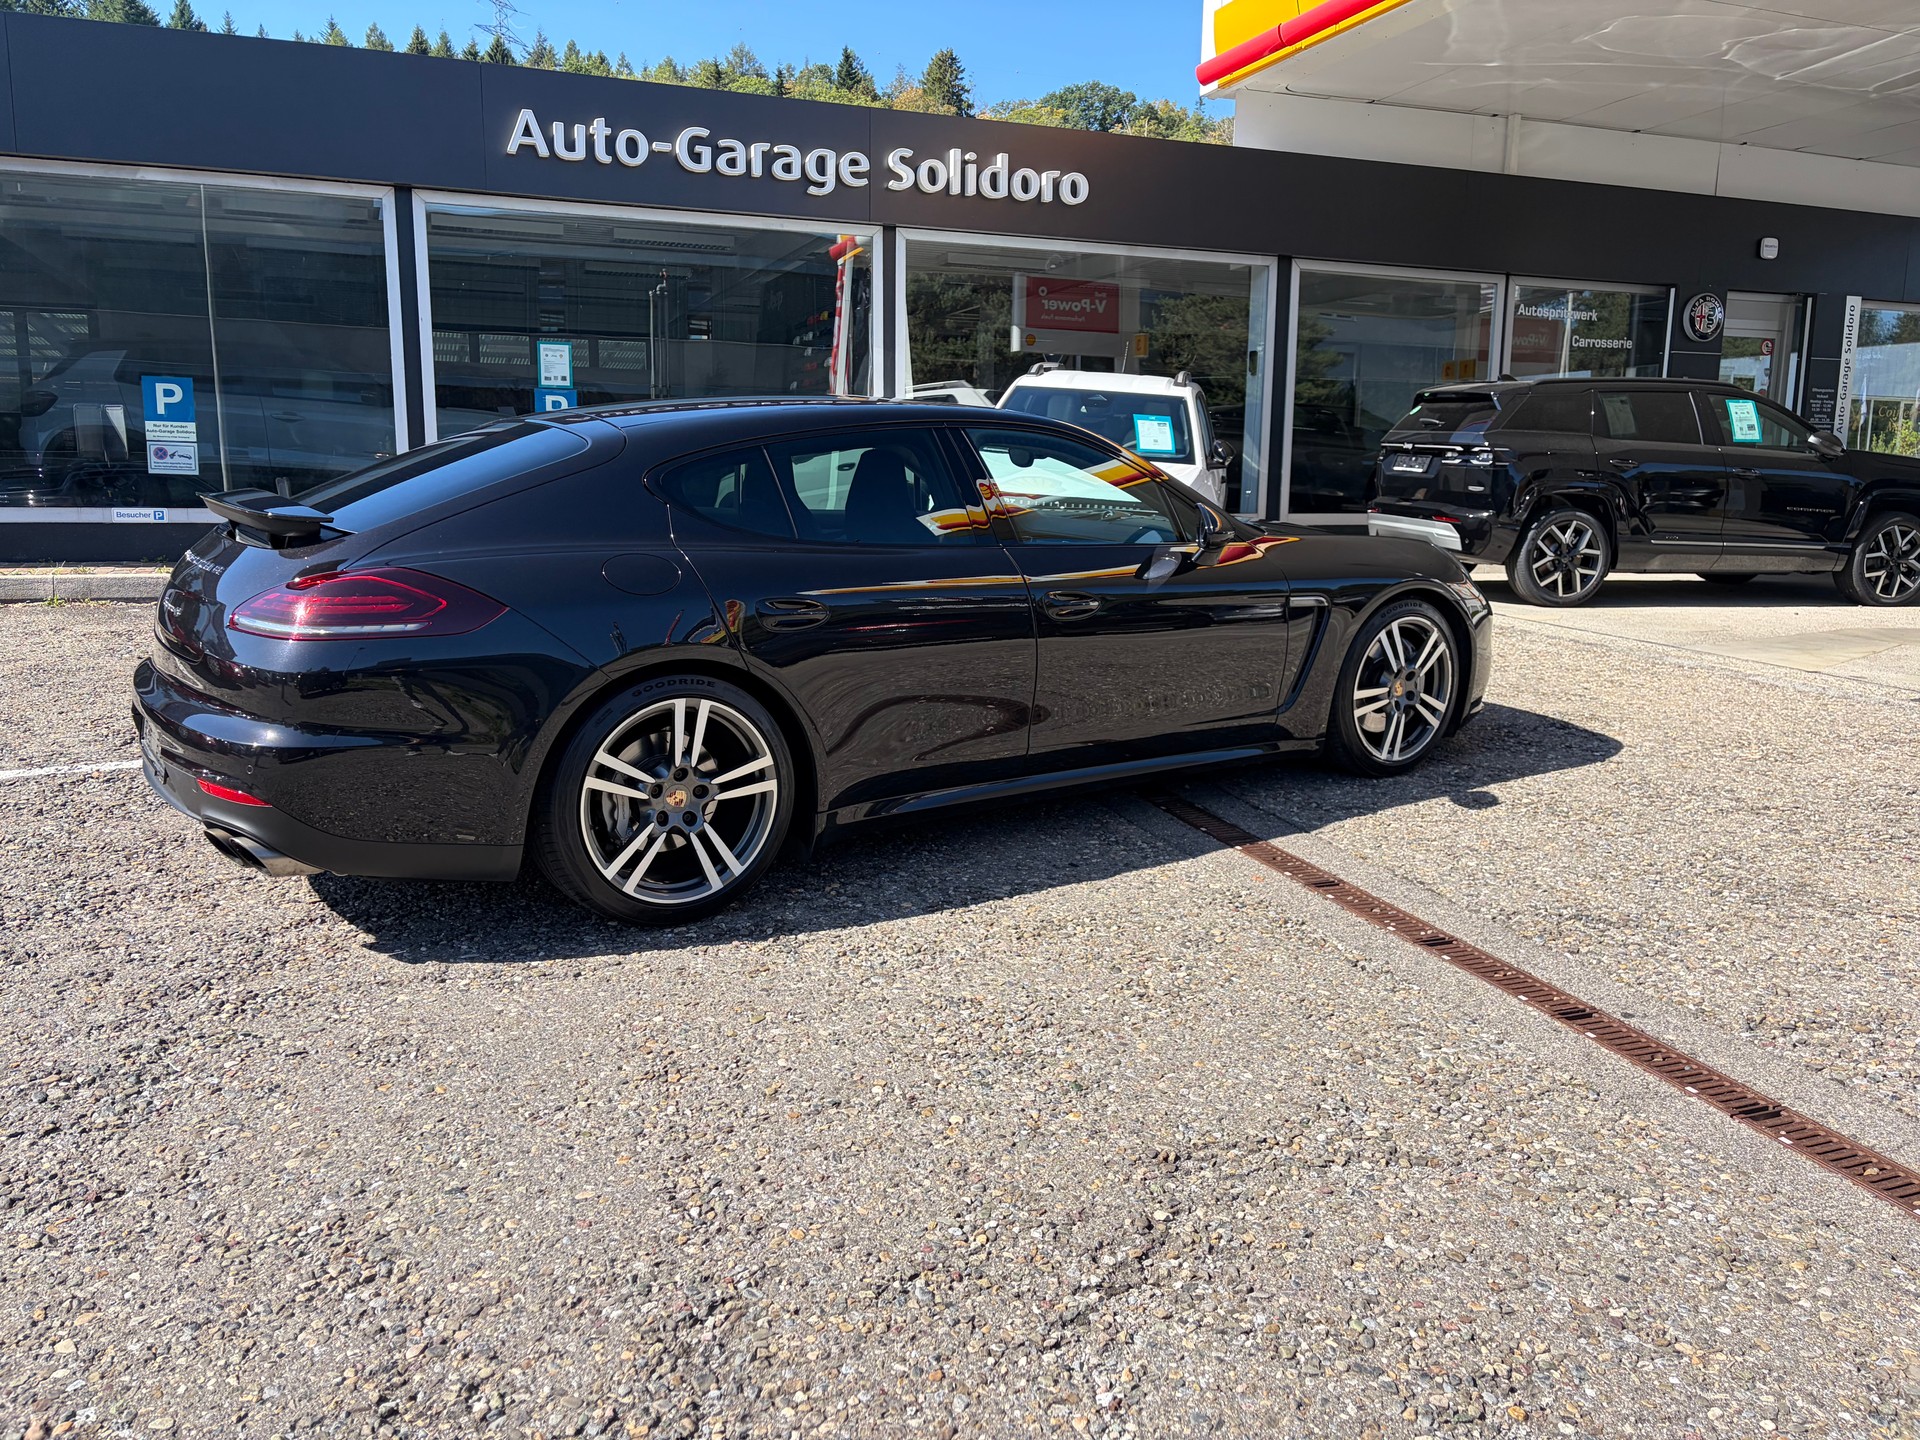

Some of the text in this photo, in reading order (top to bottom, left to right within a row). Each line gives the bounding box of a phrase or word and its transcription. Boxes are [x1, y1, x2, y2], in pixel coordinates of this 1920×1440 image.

[507, 108, 1090, 205] Auto-Garage Solidoro
[1517, 303, 1598, 321] Autospritzwerk
[1690, 298, 1704, 317] ALFA
[1572, 335, 1633, 349] Carrosserie
[1836, 304, 1856, 434] Auto-Garage Solidoro
[155, 383, 183, 415] P
[116, 511, 151, 519] Besucher
[632, 678, 716, 697] GOODRIDE
